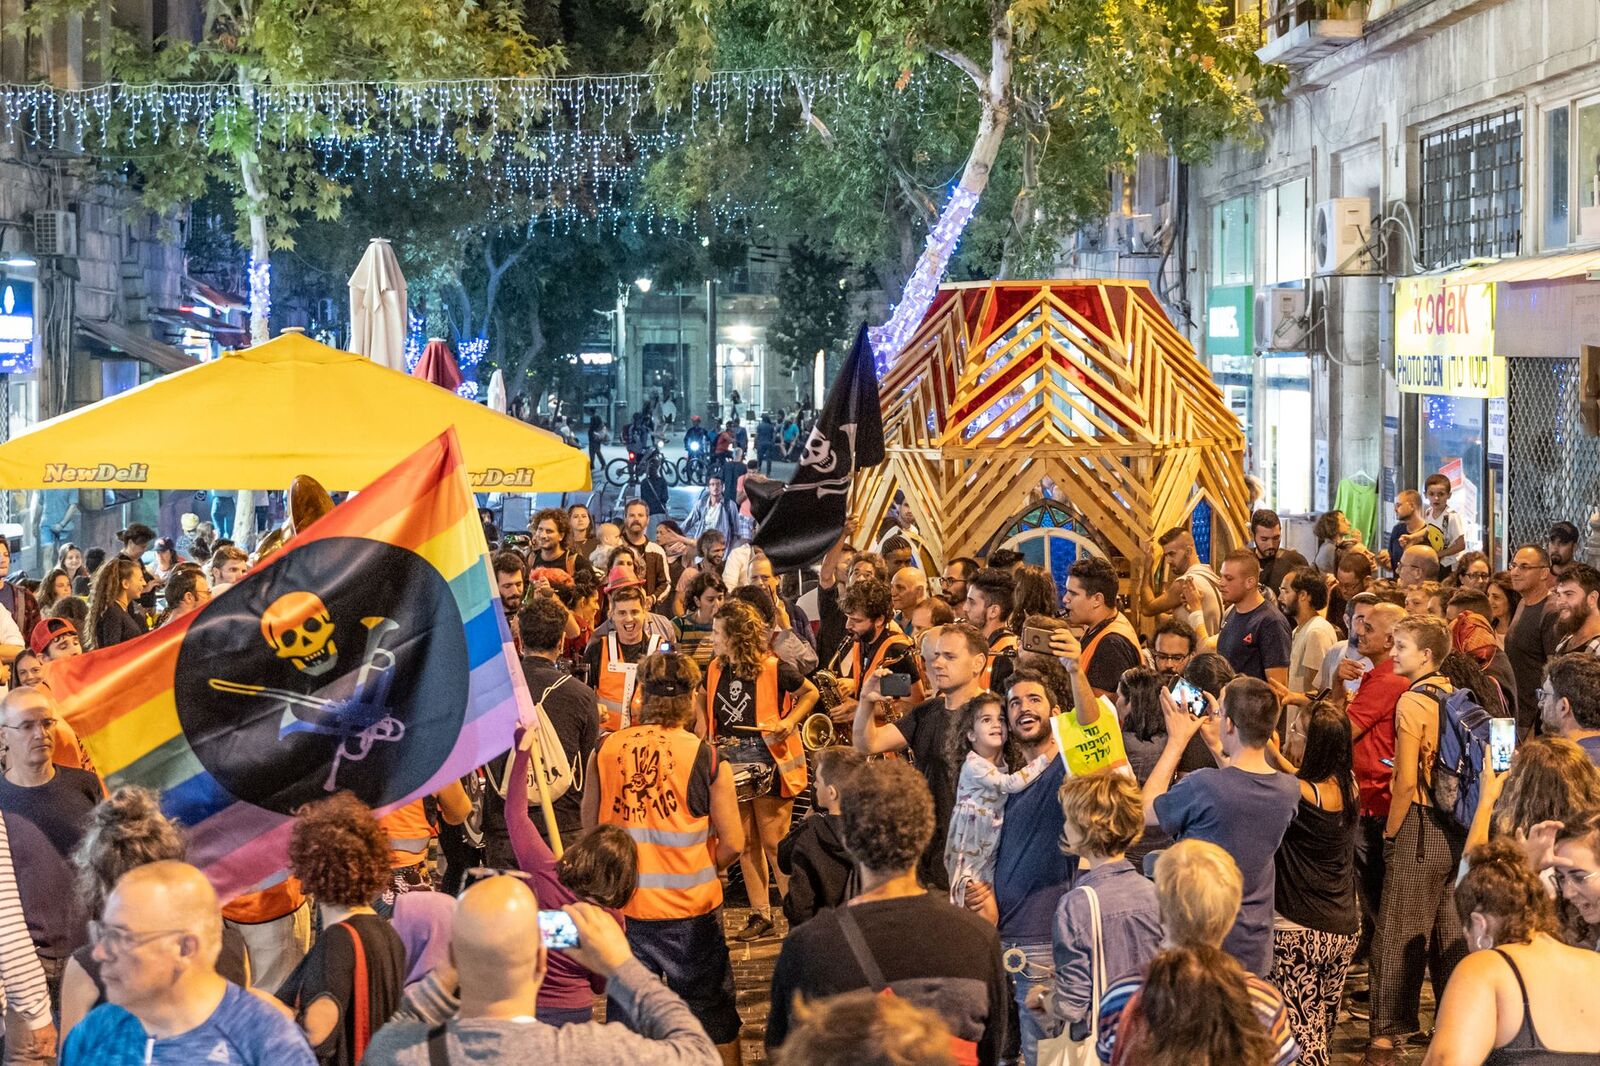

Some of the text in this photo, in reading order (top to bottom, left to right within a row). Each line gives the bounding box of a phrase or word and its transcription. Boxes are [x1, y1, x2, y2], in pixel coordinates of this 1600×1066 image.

[1397, 354, 1443, 387] PHOTO EDEN
[43, 463, 149, 482] NewDeli
[467, 467, 535, 487] wDeli
[1074, 731, 1112, 753] הסיפור
